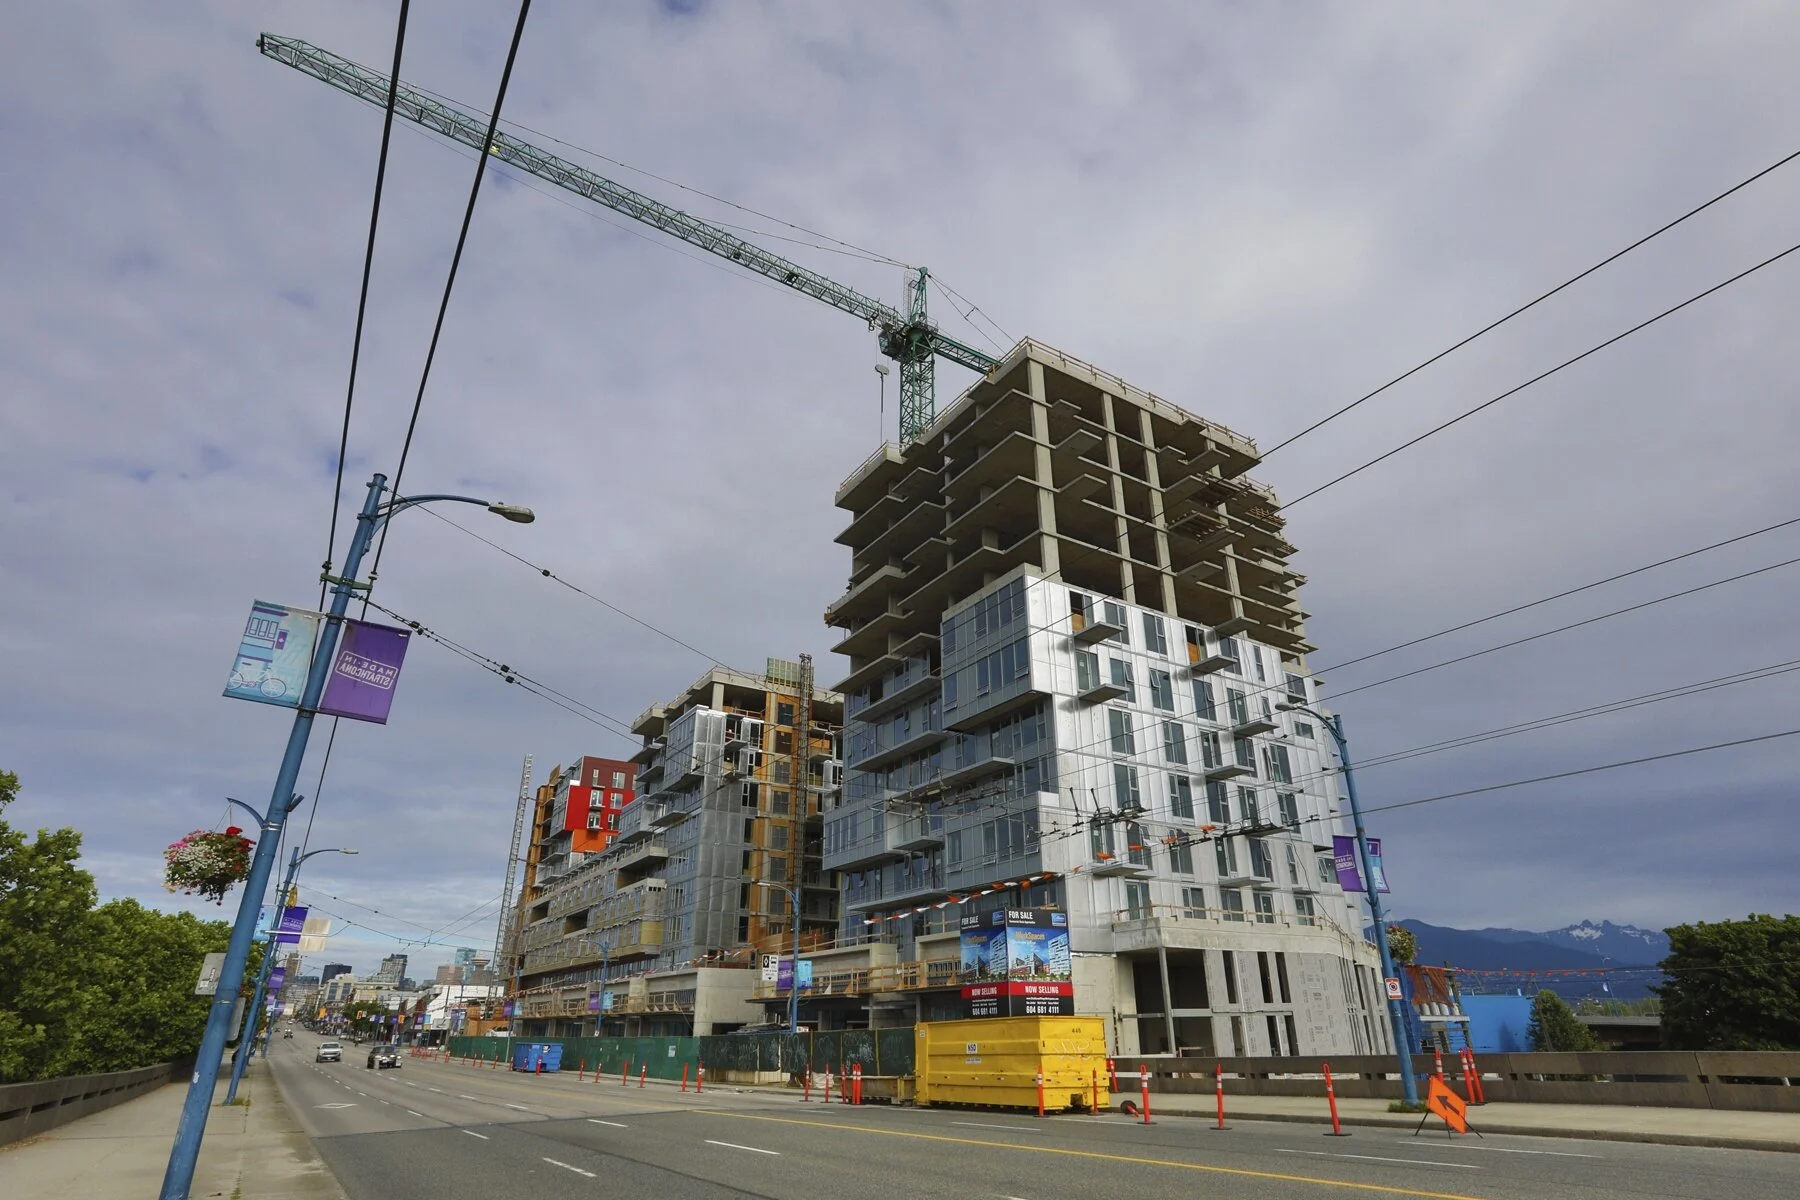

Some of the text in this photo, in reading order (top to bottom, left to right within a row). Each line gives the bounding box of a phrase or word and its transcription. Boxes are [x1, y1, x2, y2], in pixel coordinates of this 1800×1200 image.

[1008, 910, 1020, 919] FOR
[1020, 911, 1033, 920] SALE
[961, 915, 979, 925] FOR SALE
[971, 987, 997, 996] NOW SELLING
[1024, 985, 1059, 994] NOW SELLING
[1026, 1005, 1059, 1014] 604 681 4111
